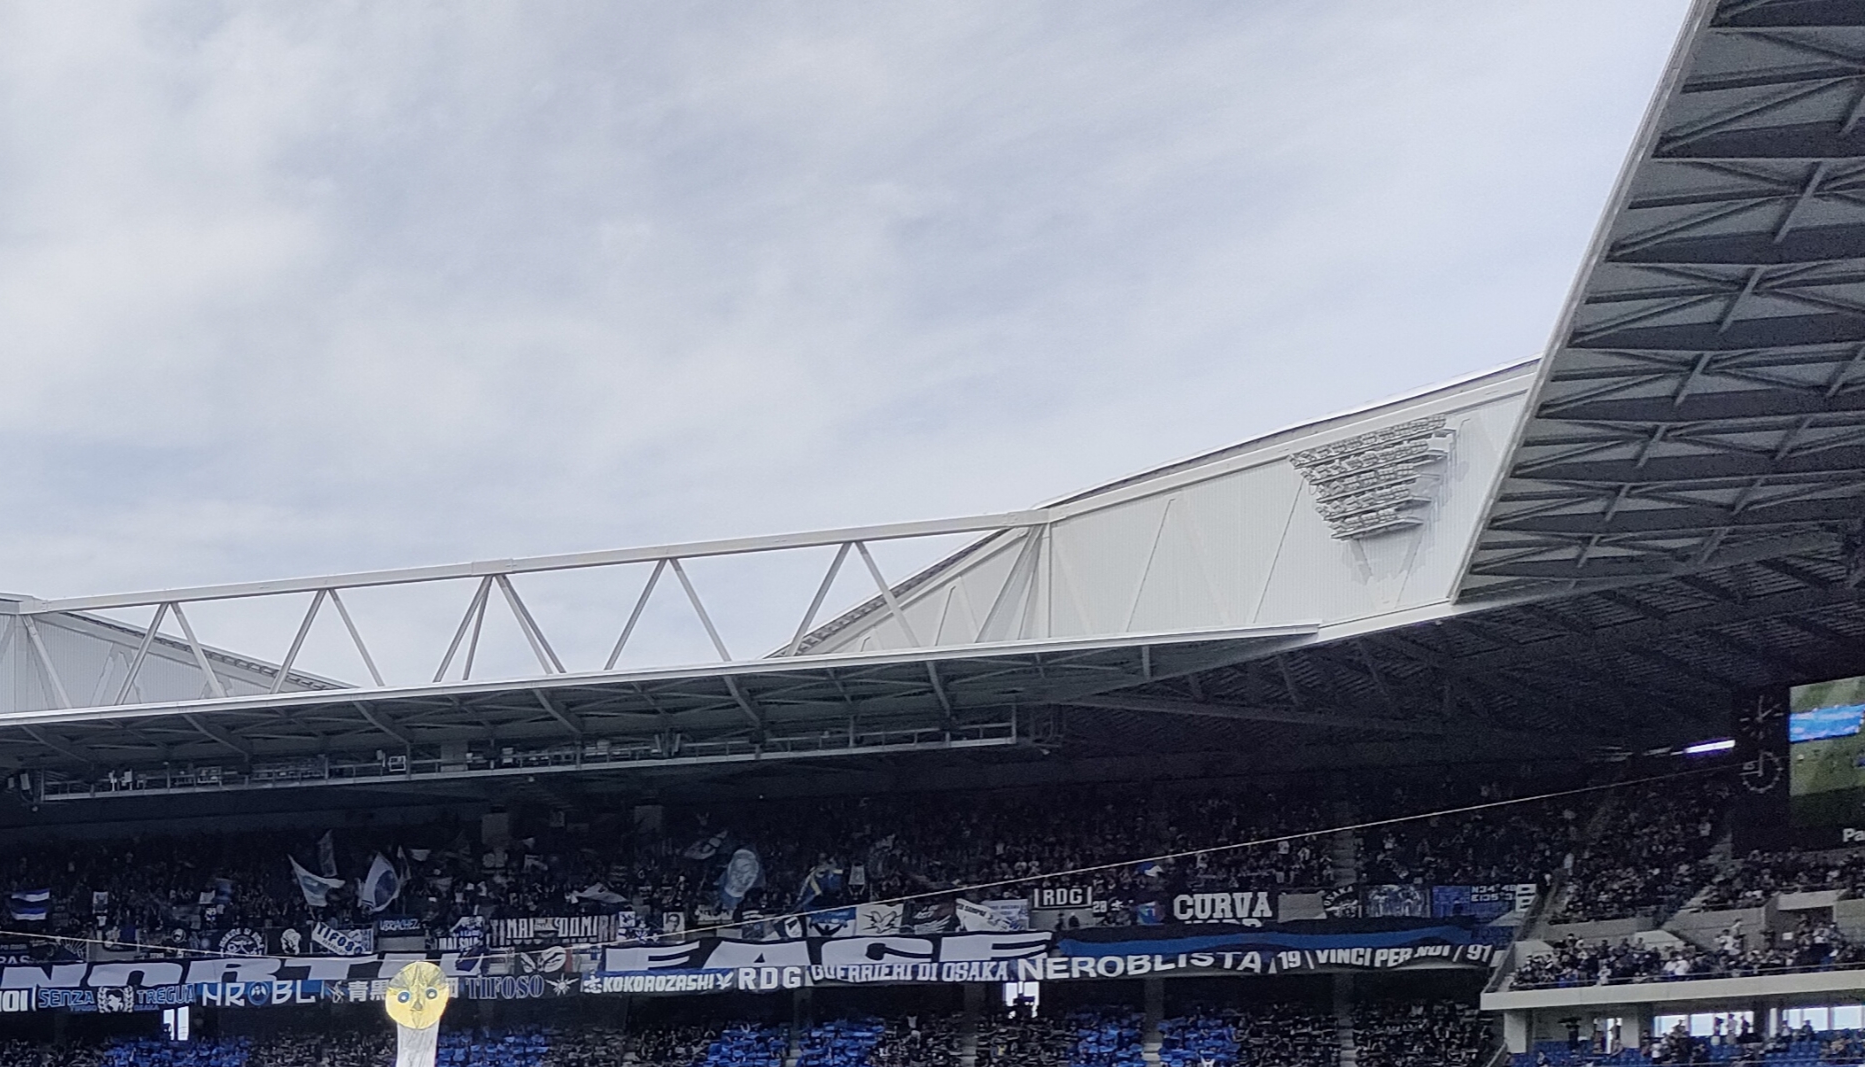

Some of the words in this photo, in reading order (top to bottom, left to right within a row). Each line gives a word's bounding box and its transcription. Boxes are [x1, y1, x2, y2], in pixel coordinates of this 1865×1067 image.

[1043, 888, 1082, 905] RDG
[1173, 892, 1272, 920] CURVA
[1017, 952, 1262, 982] NEROBLISTA
[1277, 950, 1301, 970] 19
[1316, 947, 1372, 967] VINCI
[602, 972, 715, 993] KOKOROZASHI
[738, 966, 801, 990] RDG
[917, 961, 937, 981] DI
[942, 961, 1008, 982] OSAKA
[38, 988, 95, 1009] SENZA
[136, 984, 196, 1005] TREGUA
[465, 974, 544, 1000] TIFOSO
